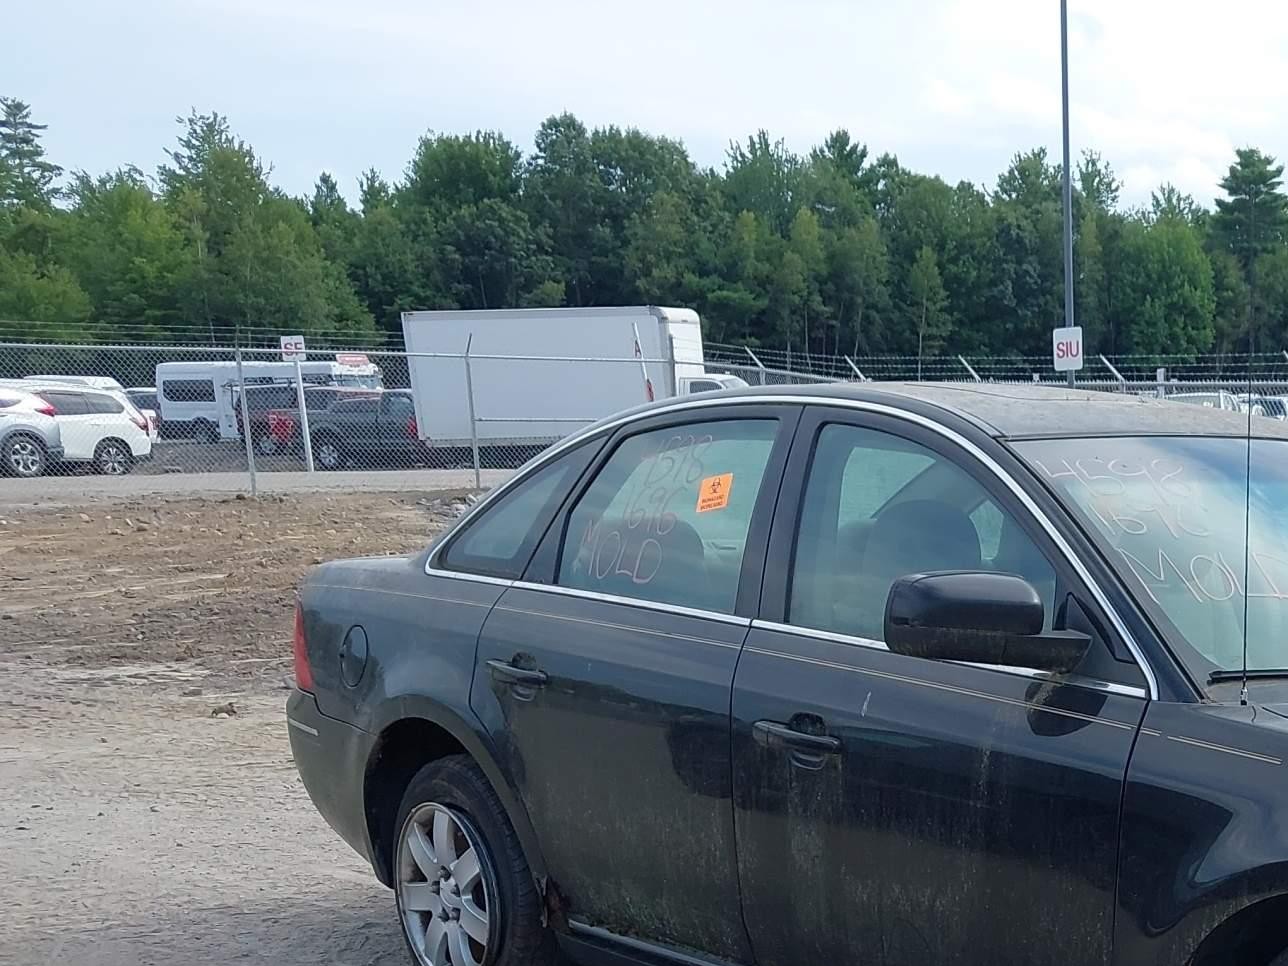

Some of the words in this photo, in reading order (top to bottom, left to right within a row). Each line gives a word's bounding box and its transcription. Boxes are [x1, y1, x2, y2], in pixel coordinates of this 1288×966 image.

[284, 342, 303, 357] SF
[1056, 340, 1080, 359] SIU
[1036, 458, 1193, 505] 4598
[623, 485, 689, 535] 1696
[573, 519, 662, 584] MOLD
